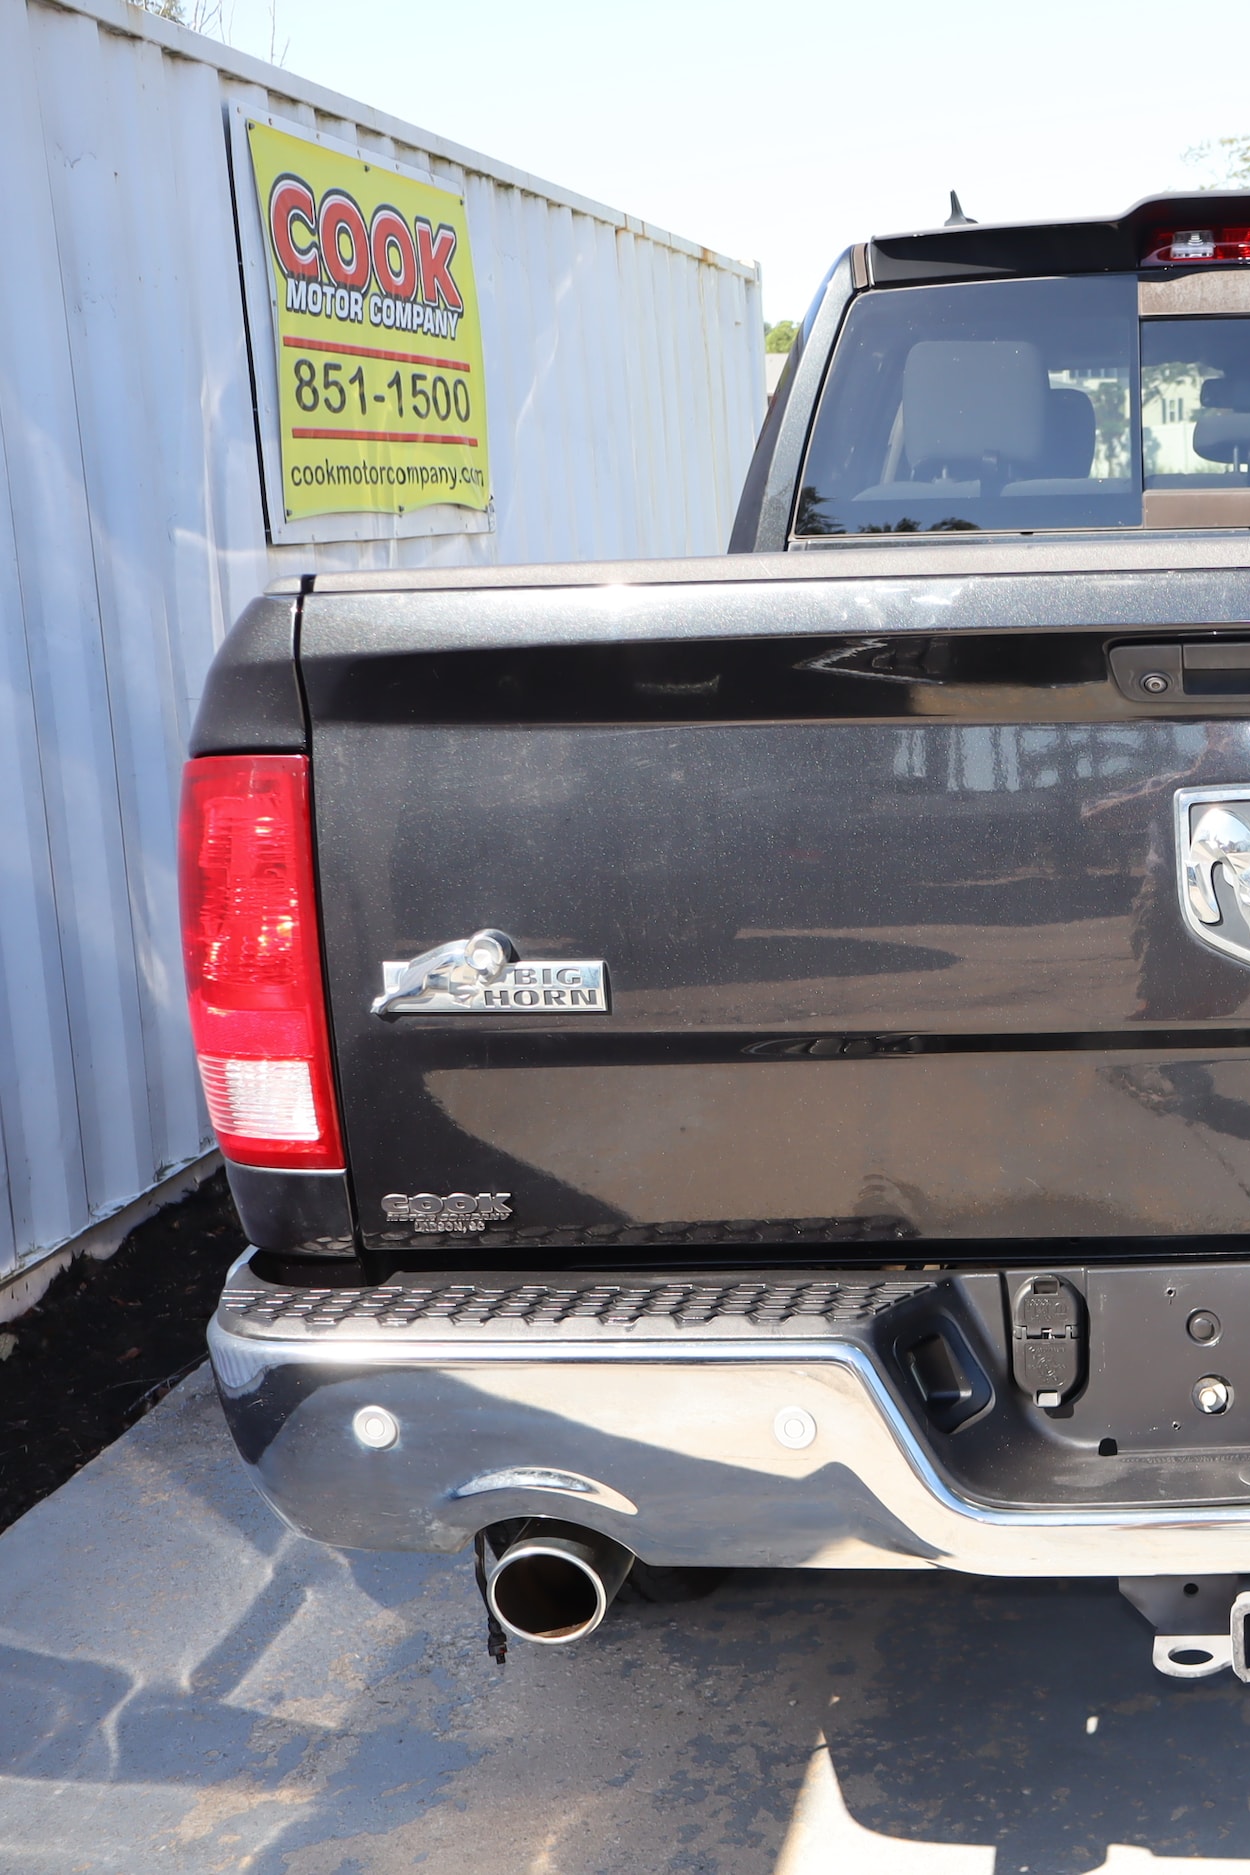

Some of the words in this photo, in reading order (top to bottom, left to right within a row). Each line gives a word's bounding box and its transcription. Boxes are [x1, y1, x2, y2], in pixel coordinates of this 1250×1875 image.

[268, 172, 464, 317] COOK
[286, 277, 364, 325] MOTOR
[369, 294, 460, 341] COMPANY
[294, 358, 471, 423] 851-1500
[484, 989, 597, 1006] HORN
[513, 967, 582, 987] BIG
[381, 1193, 513, 1213] COOK
